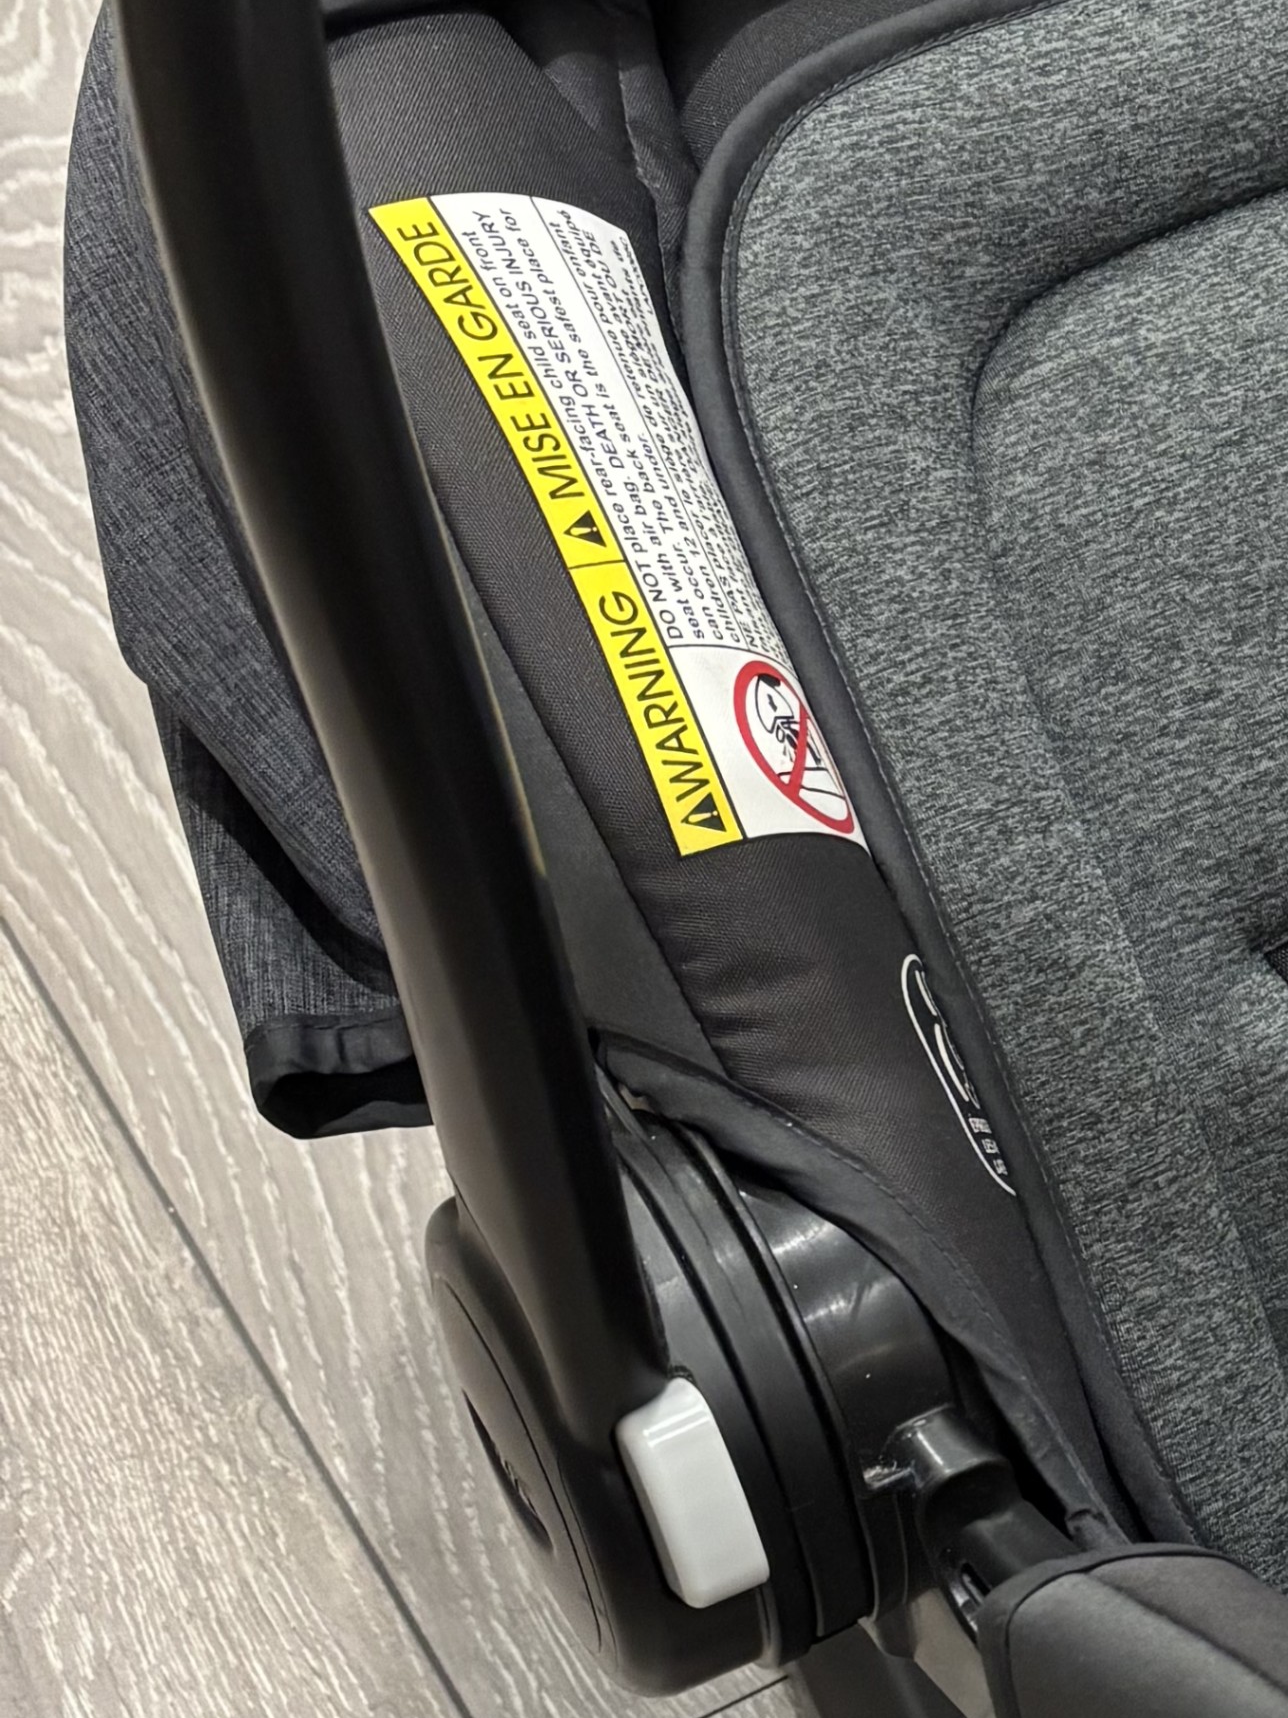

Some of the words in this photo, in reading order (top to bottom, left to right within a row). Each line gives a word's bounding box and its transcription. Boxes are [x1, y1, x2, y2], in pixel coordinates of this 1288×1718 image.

[498, 208, 521, 232] for
[460, 230, 497, 271] front
[471, 210, 523, 274] INJURY
[516, 237, 554, 284] place
[396, 221, 498, 341] GARDE
[491, 276, 512, 298] on
[504, 303, 537, 340] seat
[514, 280, 571, 363] SERIOUS
[542, 288, 581, 343] safest
[476, 352, 535, 400] EN
[526, 345, 563, 389] child
[577, 348, 598, 376] the
[563, 369, 588, 398] OR
[594, 382, 610, 398] is
[580, 403, 625, 469] DEATH
[602, 403, 631, 442] seat
[509, 412, 586, 501] MISE
[557, 395, 617, 496] rear-facing
[625, 449, 655, 493] back
[622, 476, 647, 516] bag.
[651, 498, 674, 534] The
[663, 494, 689, 531] and
[611, 501, 648, 553] place
[641, 520, 662, 546] air
[682, 535, 701, 556] 12
[634, 559, 667, 602] NOT
[656, 552, 683, 592] with
[671, 541, 705, 600] occur.
[658, 608, 684, 639] DO
[675, 598, 705, 639] seat
[698, 564, 741, 643] children
[701, 605, 724, 640] can
[597, 590, 712, 803] WARNING
